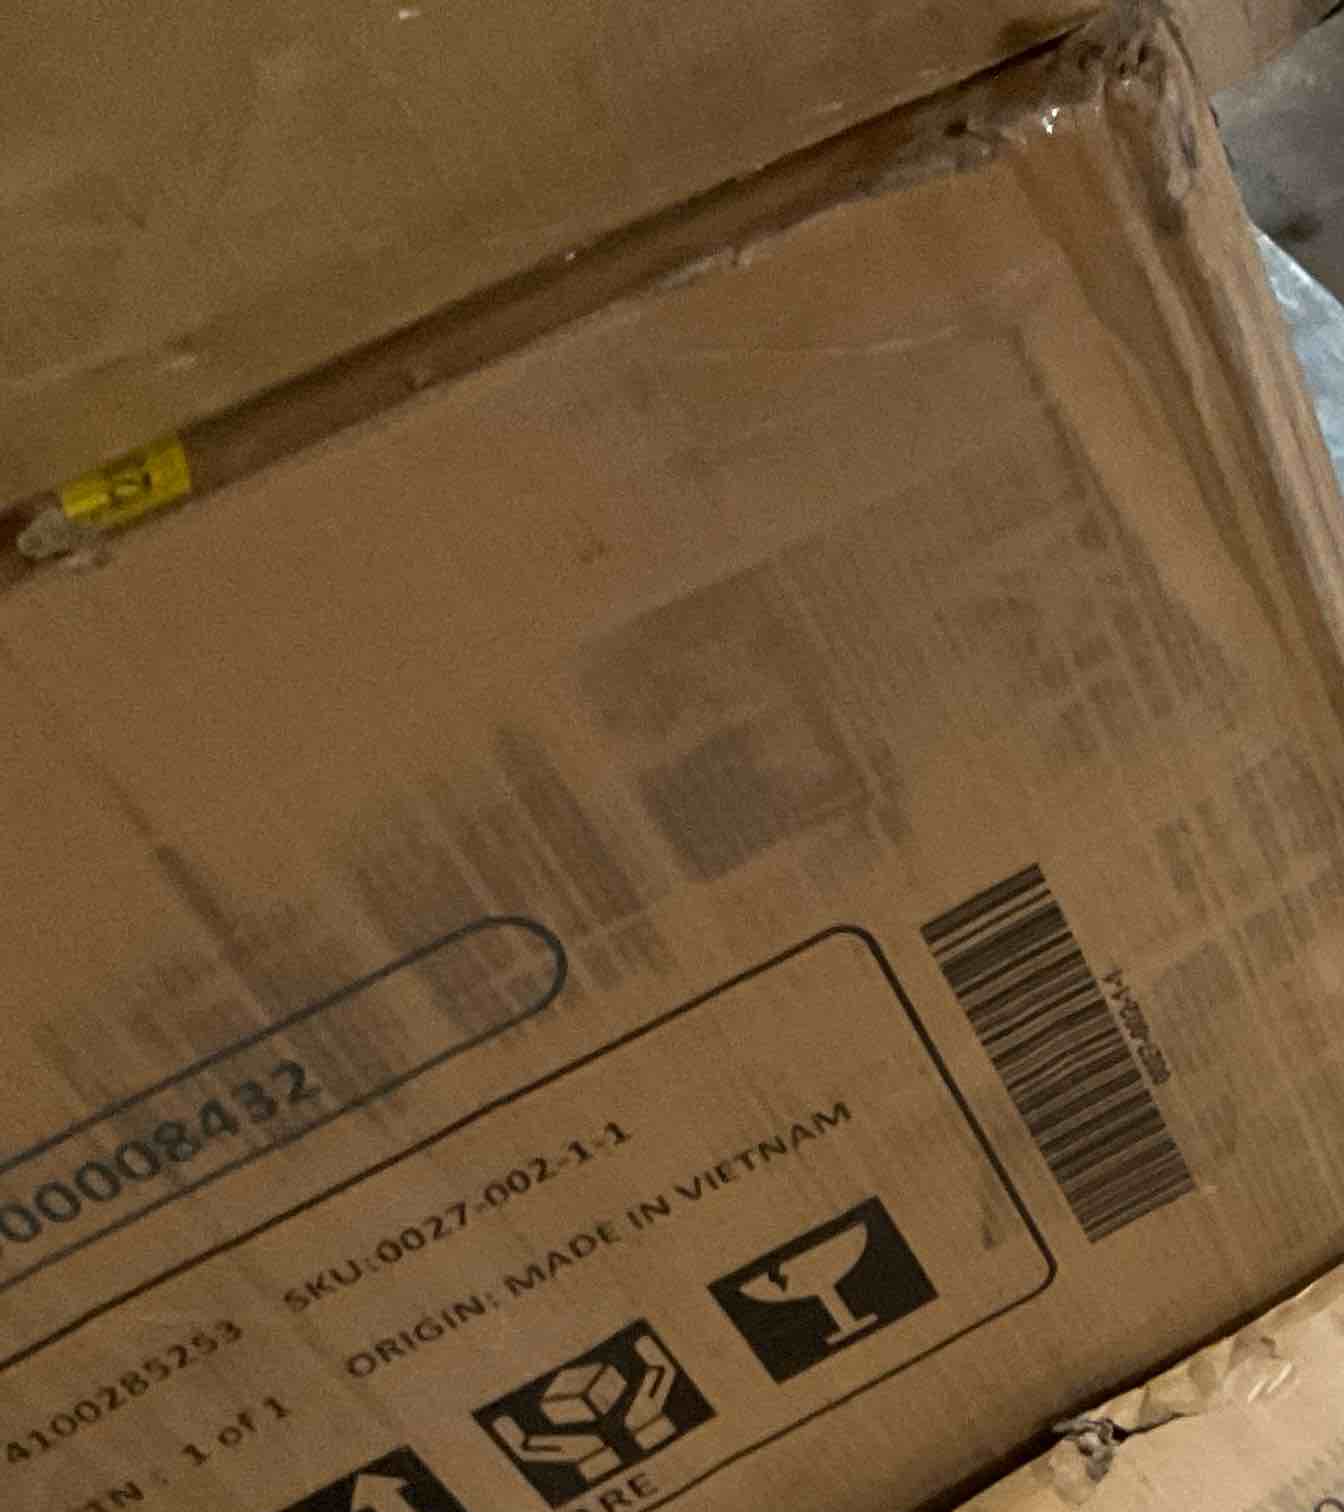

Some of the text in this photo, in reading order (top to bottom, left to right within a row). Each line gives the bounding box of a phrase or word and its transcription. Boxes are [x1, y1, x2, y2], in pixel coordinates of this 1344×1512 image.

[181, 1443, 210, 1467] 1
[217, 1410, 259, 1449] of
[263, 1396, 292, 1420] 1
[345, 1292, 497, 1379] ORIGIN:
[504, 1224, 619, 1299] MADE
[631, 1194, 673, 1233] IN
[673, 1100, 854, 1201] VIETNAM
